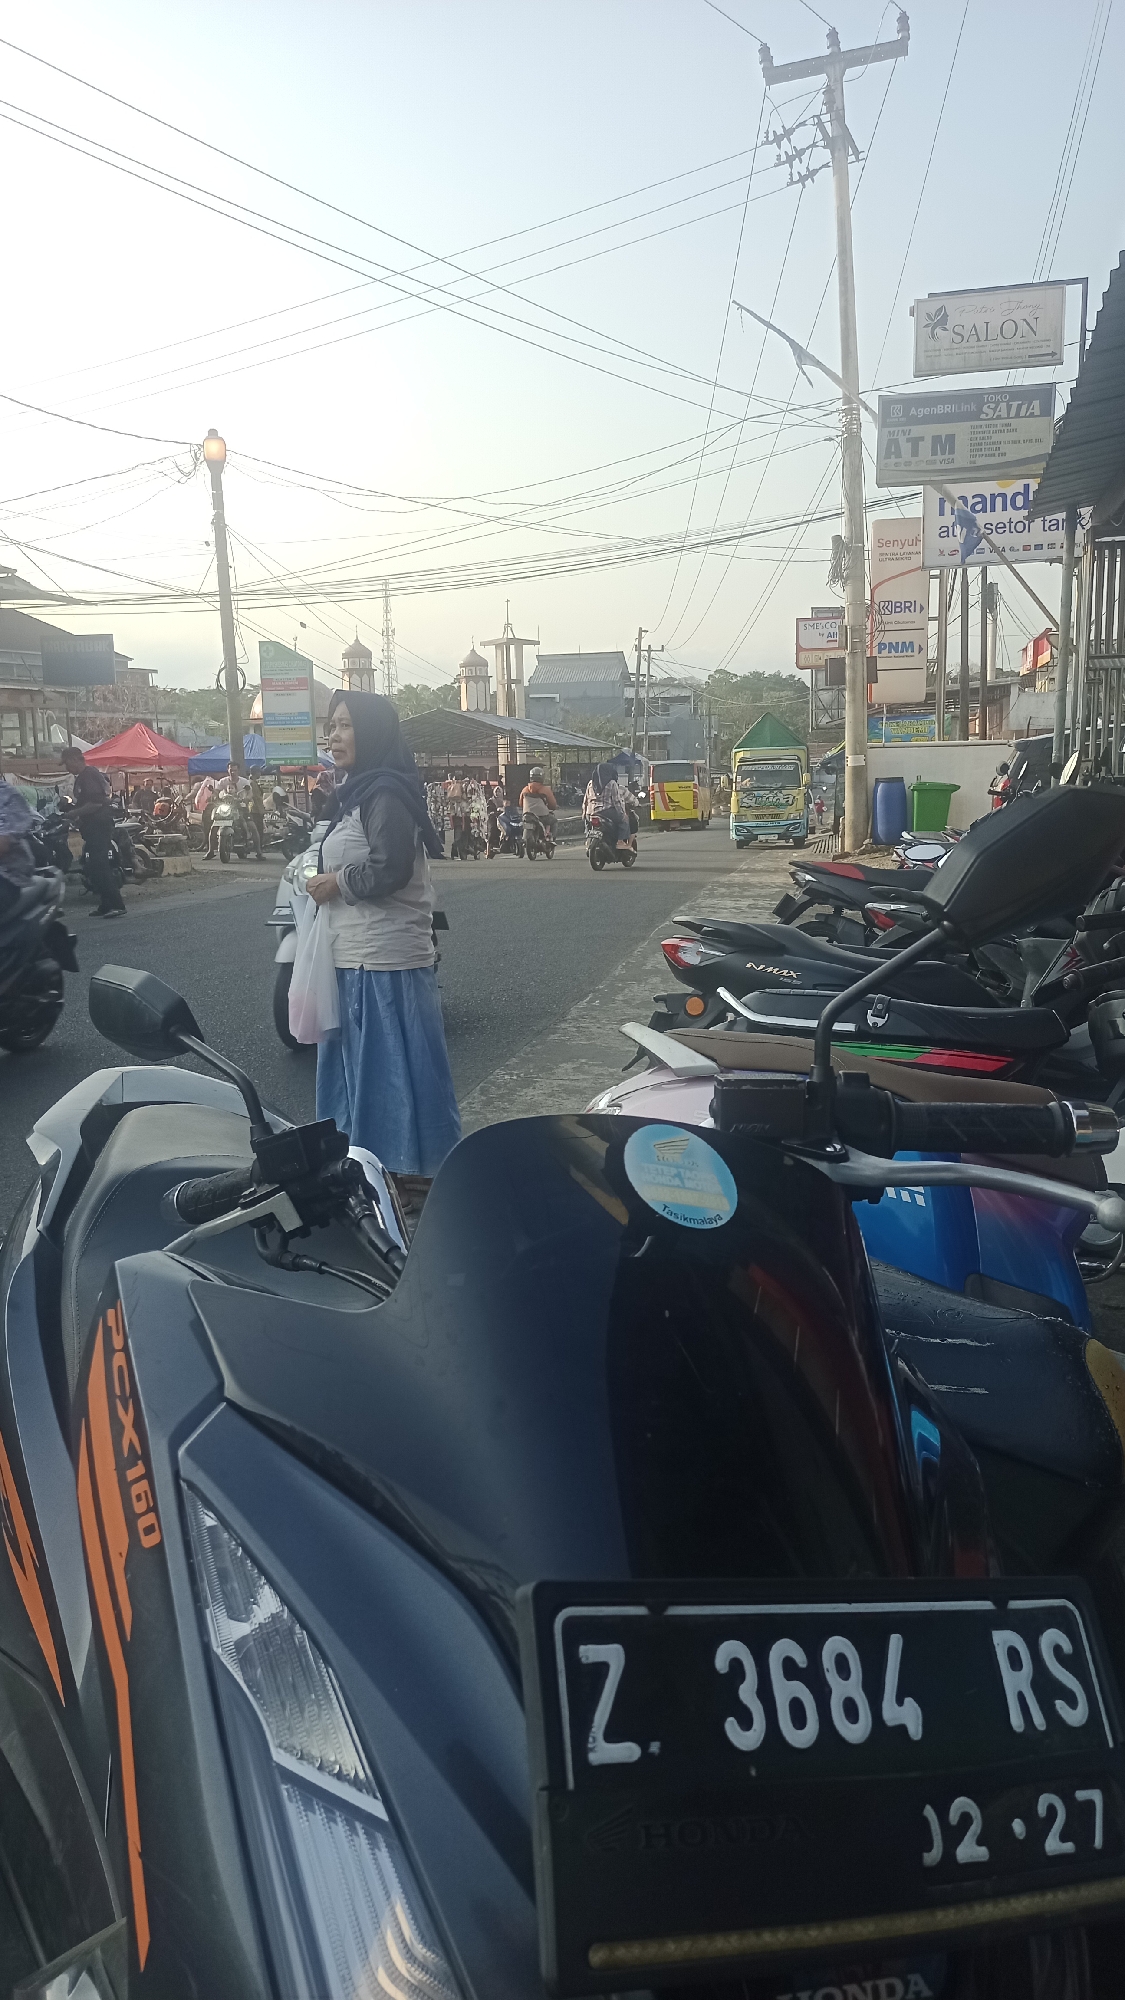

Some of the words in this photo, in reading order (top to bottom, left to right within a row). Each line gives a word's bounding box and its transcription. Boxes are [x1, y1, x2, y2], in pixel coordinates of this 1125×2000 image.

[951, 316, 1040, 345] SALON
[983, 393, 1010, 403] TOKO
[886, 428, 912, 438] MINI
[883, 433, 956, 460] ATM
[939, 457, 955, 465] VISA
[983, 517, 1035, 537] setor
[893, 600, 917, 614] BRI
[877, 641, 915, 655] PNM
[745, 962, 802, 978] NMAX
[661, 1203, 724, 1226] Tasikmalaya
[714, 1633, 923, 1751] 3684
[991, 1628, 1090, 1733] RS
